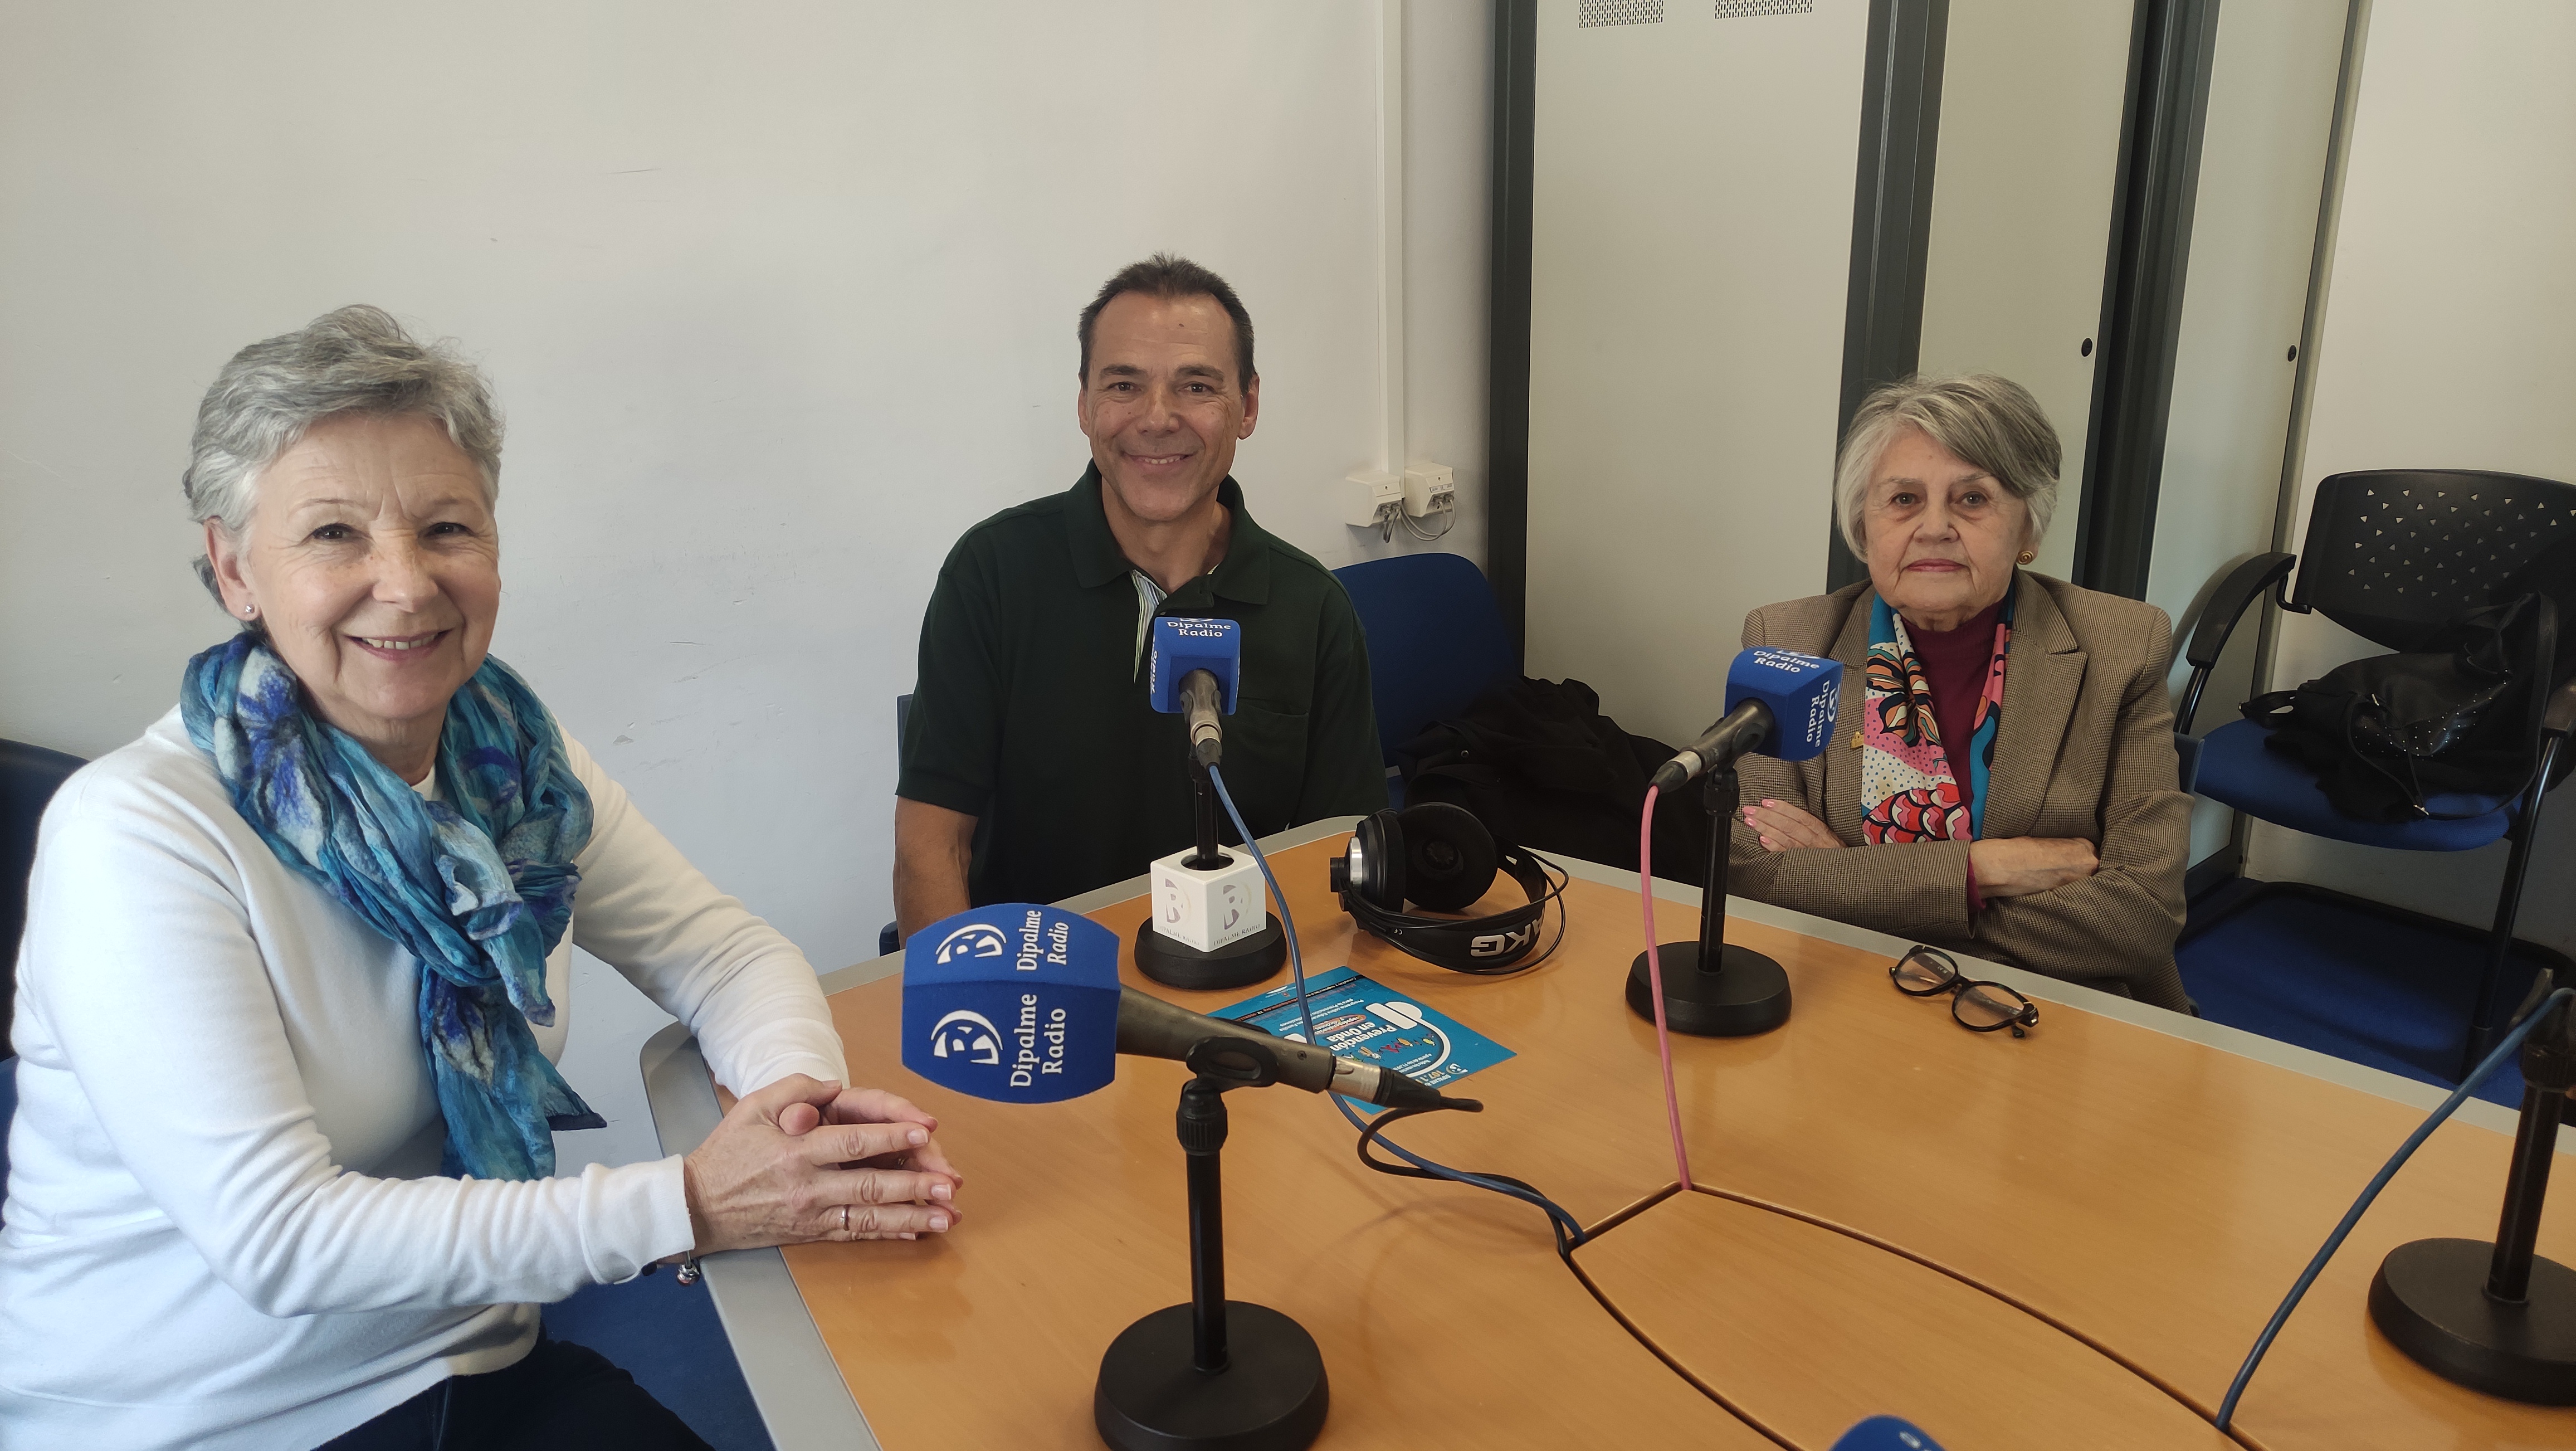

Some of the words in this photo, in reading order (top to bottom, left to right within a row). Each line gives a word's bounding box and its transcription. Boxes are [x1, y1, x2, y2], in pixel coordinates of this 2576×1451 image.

[1167, 621, 1231, 630] Dipalme
[1178, 629, 1223, 637] Radio
[1753, 650, 1820, 669] Dipalme
[1754, 658, 1801, 673] Radio
[1807, 695, 1819, 742] Radio
[1815, 680, 1830, 748] Dipalme
[1016, 910, 1044, 971] Dipalme
[1047, 922, 1069, 965] Radio
[1213, 931, 1240, 946] DIPALME
[1470, 908, 1544, 957] AKG
[1326, 1028, 1362, 1043] Onda
[1329, 1024, 1397, 1052] Prevención
[1357, 1021, 1376, 1030] en
[1010, 994, 1041, 1087] Dipalme
[1042, 1008, 1067, 1074] Radio
